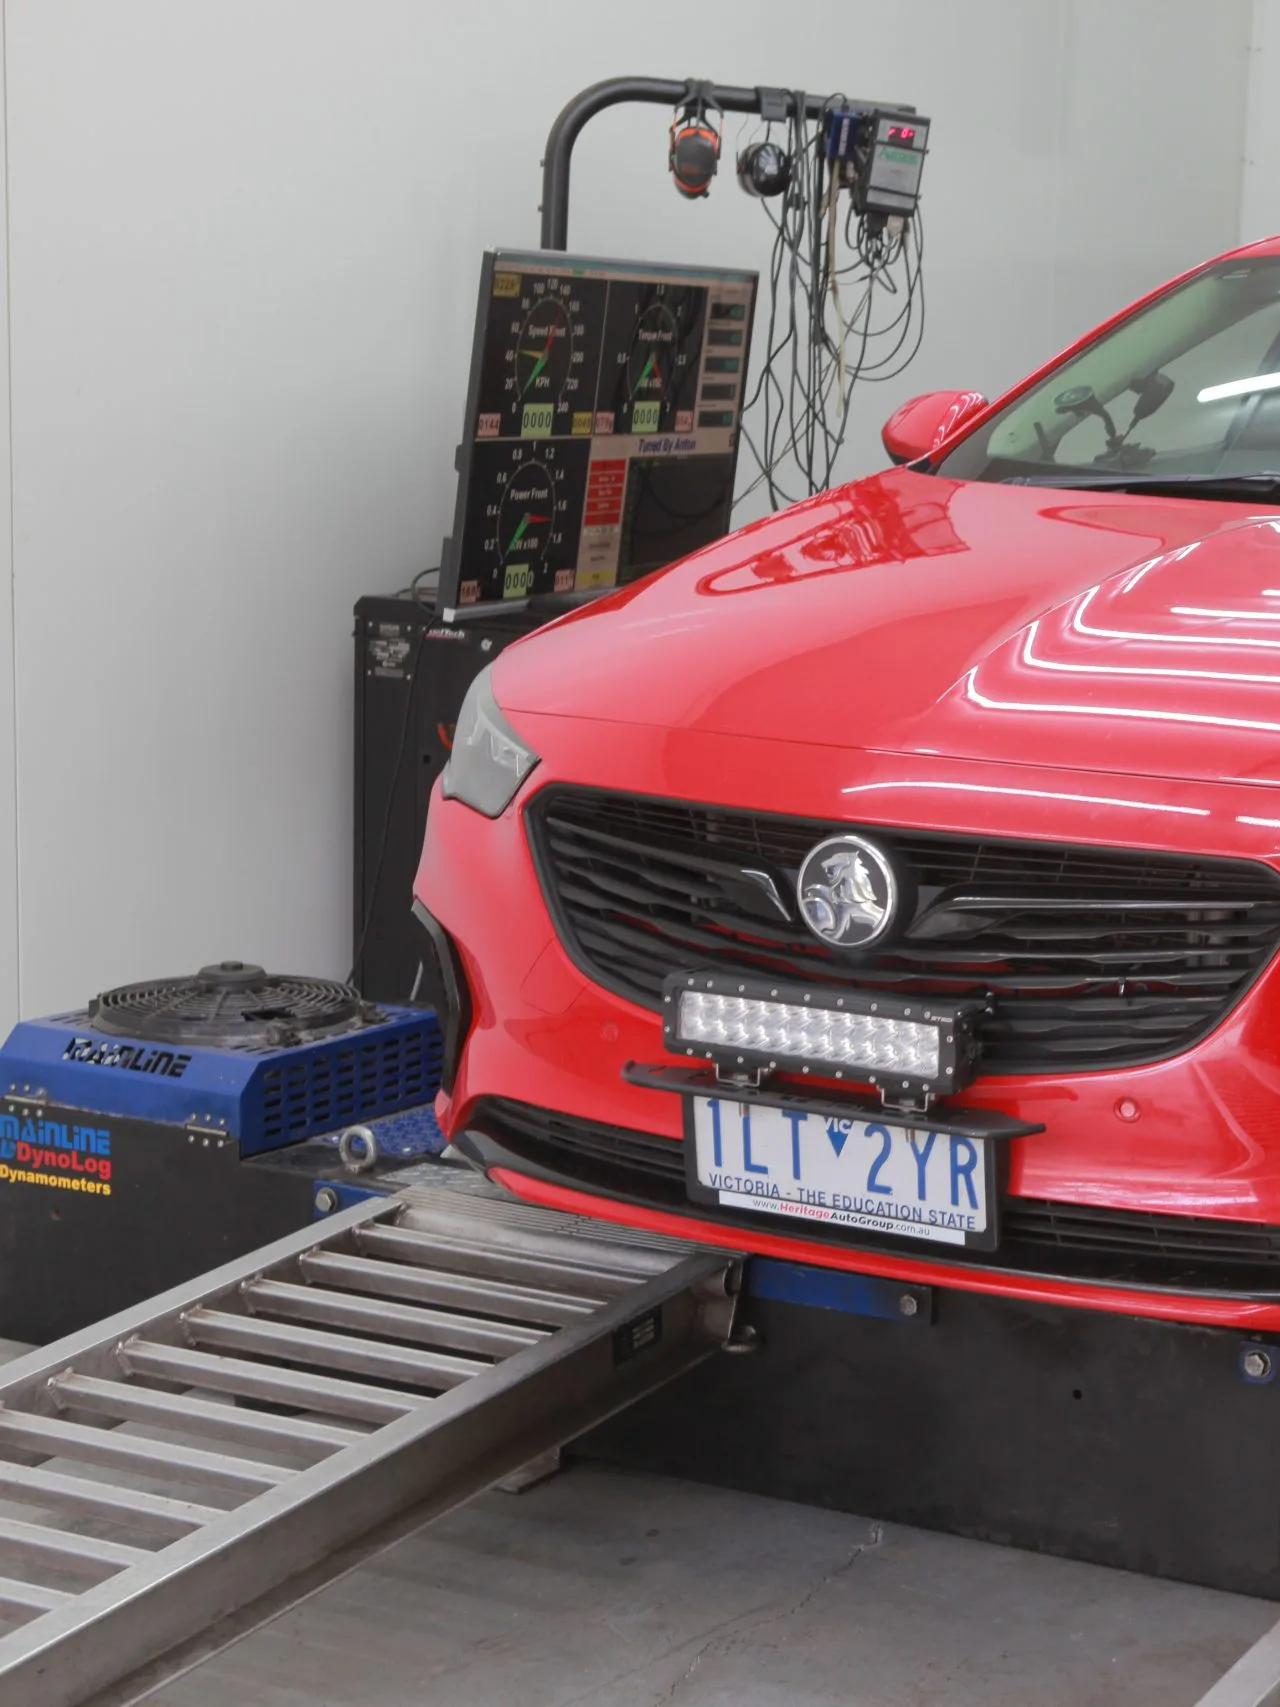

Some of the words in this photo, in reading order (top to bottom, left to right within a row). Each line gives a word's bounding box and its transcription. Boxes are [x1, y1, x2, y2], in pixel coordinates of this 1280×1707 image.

[547, 278, 558, 290] 120
[535, 377, 550, 388] KPH
[523, 412, 551, 428] 0000
[633, 408, 658, 425] 0000
[545, 448, 555, 459] 1.2
[638, 438, 662, 451] Tuned
[663, 437, 674, 454] By
[674, 437, 696, 451] Anton
[555, 470, 564, 480] 1.4
[510, 488, 530, 500] Power
[531, 487, 549, 498] Front
[486, 504, 497, 516] 0.4
[484, 539, 495, 551] 0.2
[505, 572, 534, 589] 0000
[16, 1140, 112, 1180] DynoLog
[0, 1164, 112, 1196] Dynamometers
[708, 1173, 780, 1199] VICTORIA
[796, 1187, 827, 1206] THE
[832, 1193, 922, 1222] EDUCATION
[928, 1209, 976, 1230] STATE
[752, 1199, 930, 1236] www.HeritageAutoGroup.com.au
